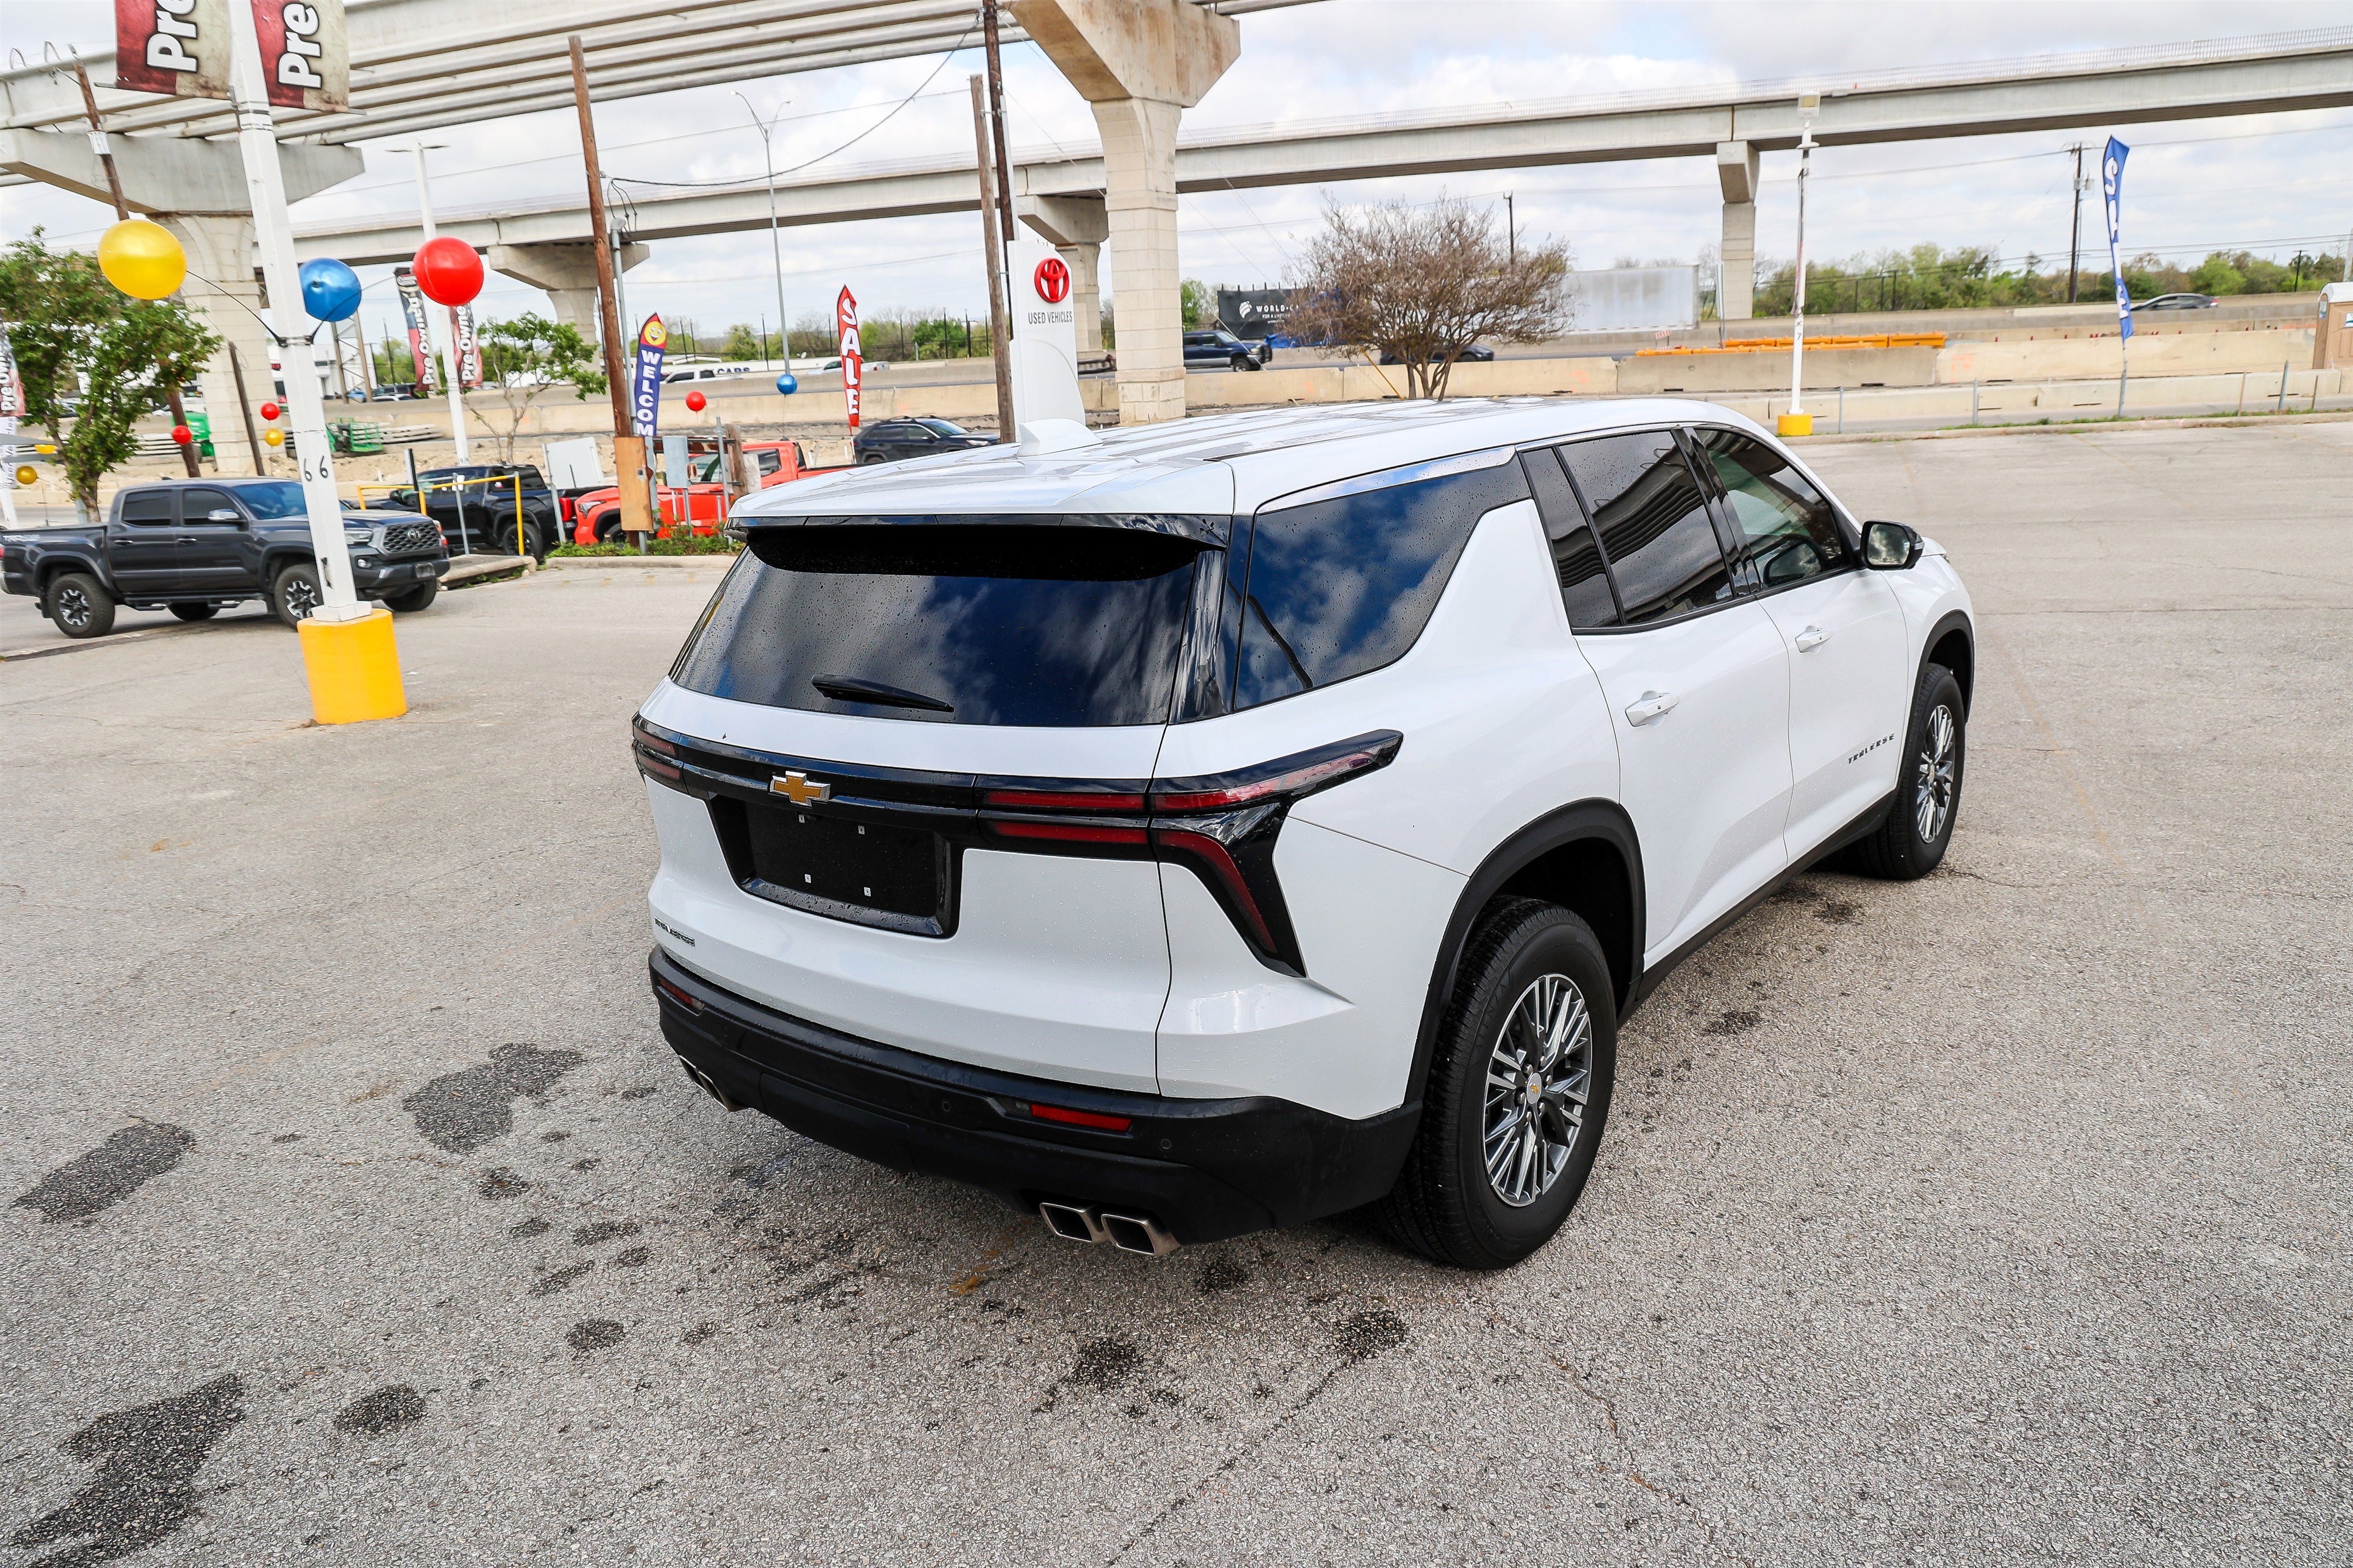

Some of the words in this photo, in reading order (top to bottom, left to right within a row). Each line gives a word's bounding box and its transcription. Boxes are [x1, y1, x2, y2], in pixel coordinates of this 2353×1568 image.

[279, 2, 322, 88] Pre
[456, 306, 472, 351] Owne
[1028, 312, 1046, 325] USED
[1047, 311, 1073, 323] VEHICLES
[422, 356, 435, 385] Pre
[461, 353, 475, 381] Pre
[841, 297, 861, 415] SALE
[1, 385, 17, 411] Pre
[637, 349, 661, 437] WELCOM
[1848, 733, 1895, 764] TRAVERSE
